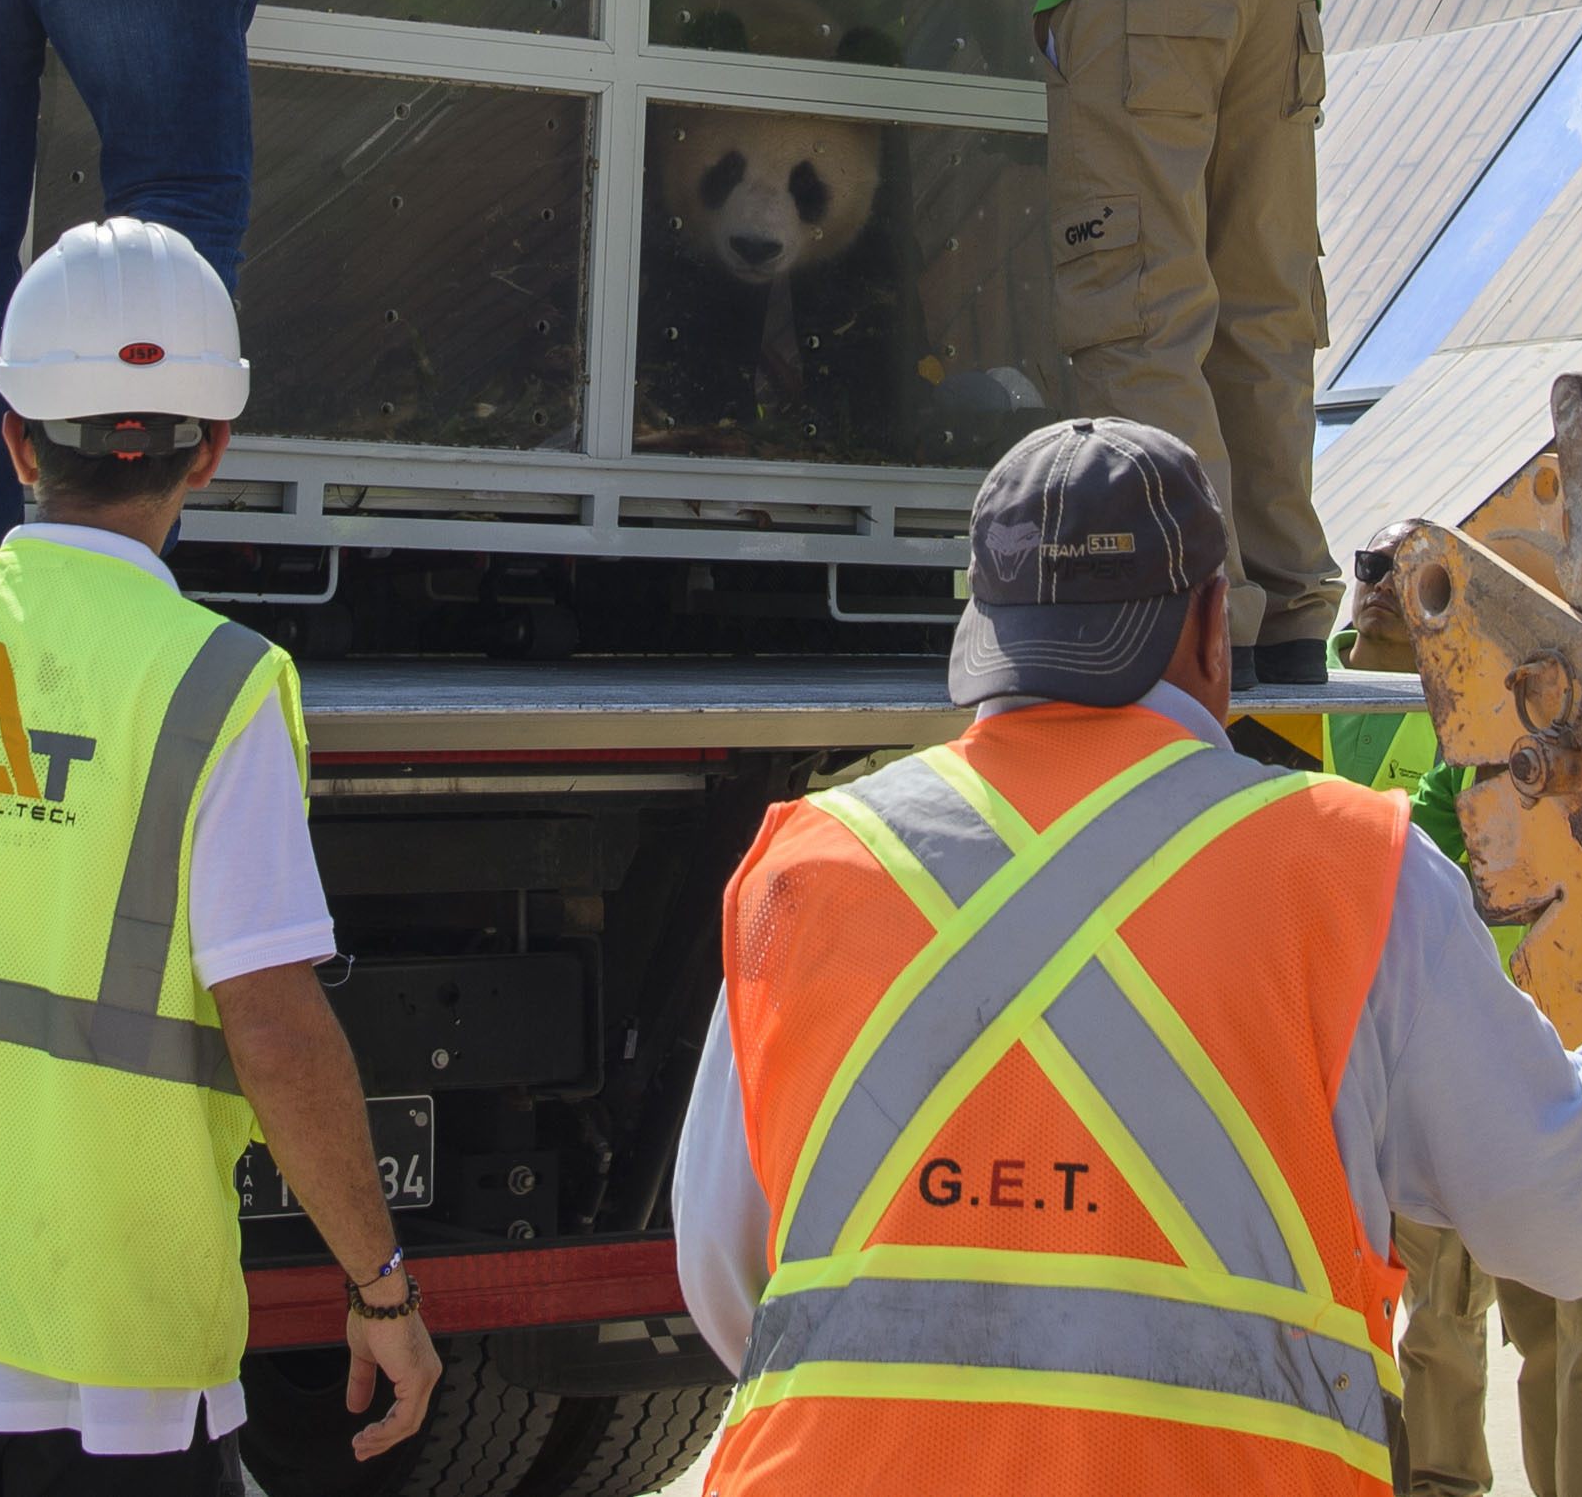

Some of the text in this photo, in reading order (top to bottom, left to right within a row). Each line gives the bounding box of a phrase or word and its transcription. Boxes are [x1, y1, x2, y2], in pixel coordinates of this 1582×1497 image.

[1064, 219, 1105, 246] GWC
[129, 347, 158, 360] JSP
[1041, 543, 1084, 558] TEAM
[918, 1157, 1098, 1213] G.E.T.
